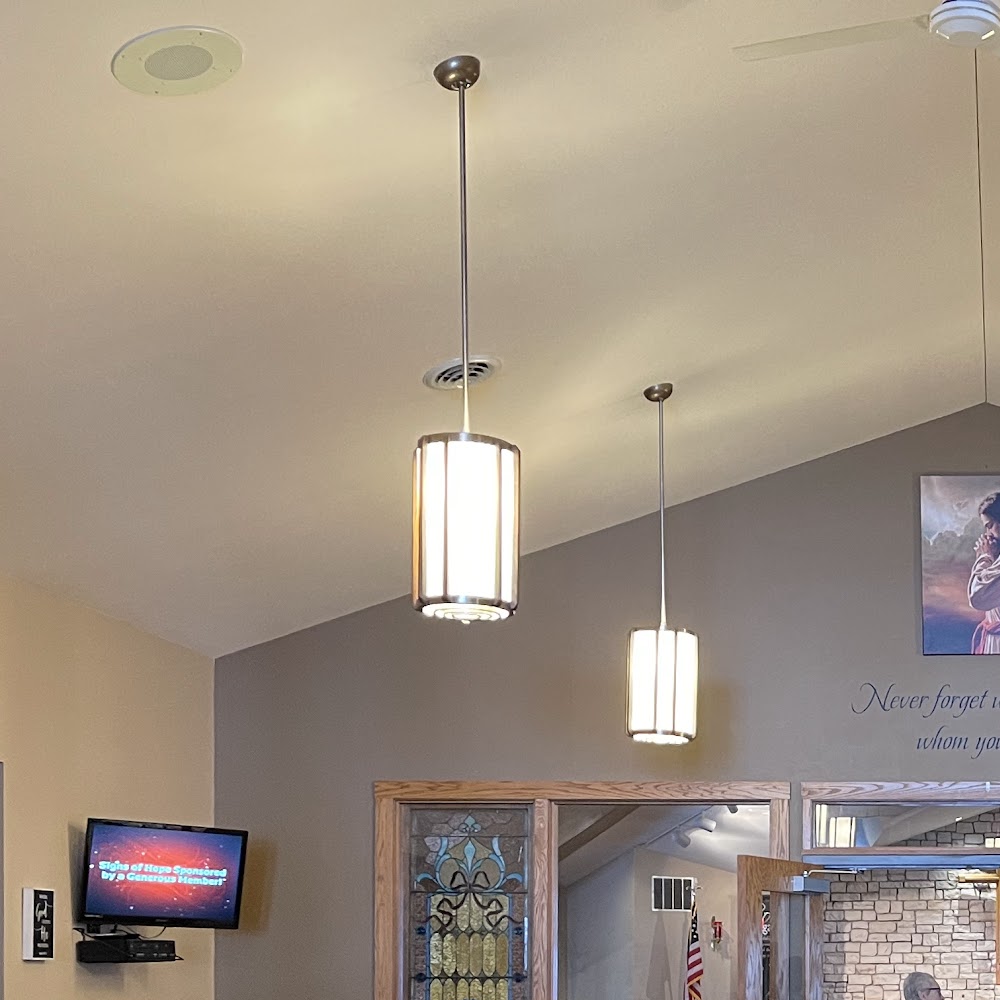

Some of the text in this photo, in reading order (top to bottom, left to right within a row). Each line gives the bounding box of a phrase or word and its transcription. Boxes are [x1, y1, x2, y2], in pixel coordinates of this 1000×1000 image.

[851, 682, 929, 714] Never
[922, 684, 989, 718] forget
[916, 725, 970, 750] whom
[101, 871, 117, 882] by
[126, 873, 177, 884] Generous
[130, 863, 144, 872] of
[143, 864, 172, 875] Hope
[173, 865, 228, 878] Sponsored
